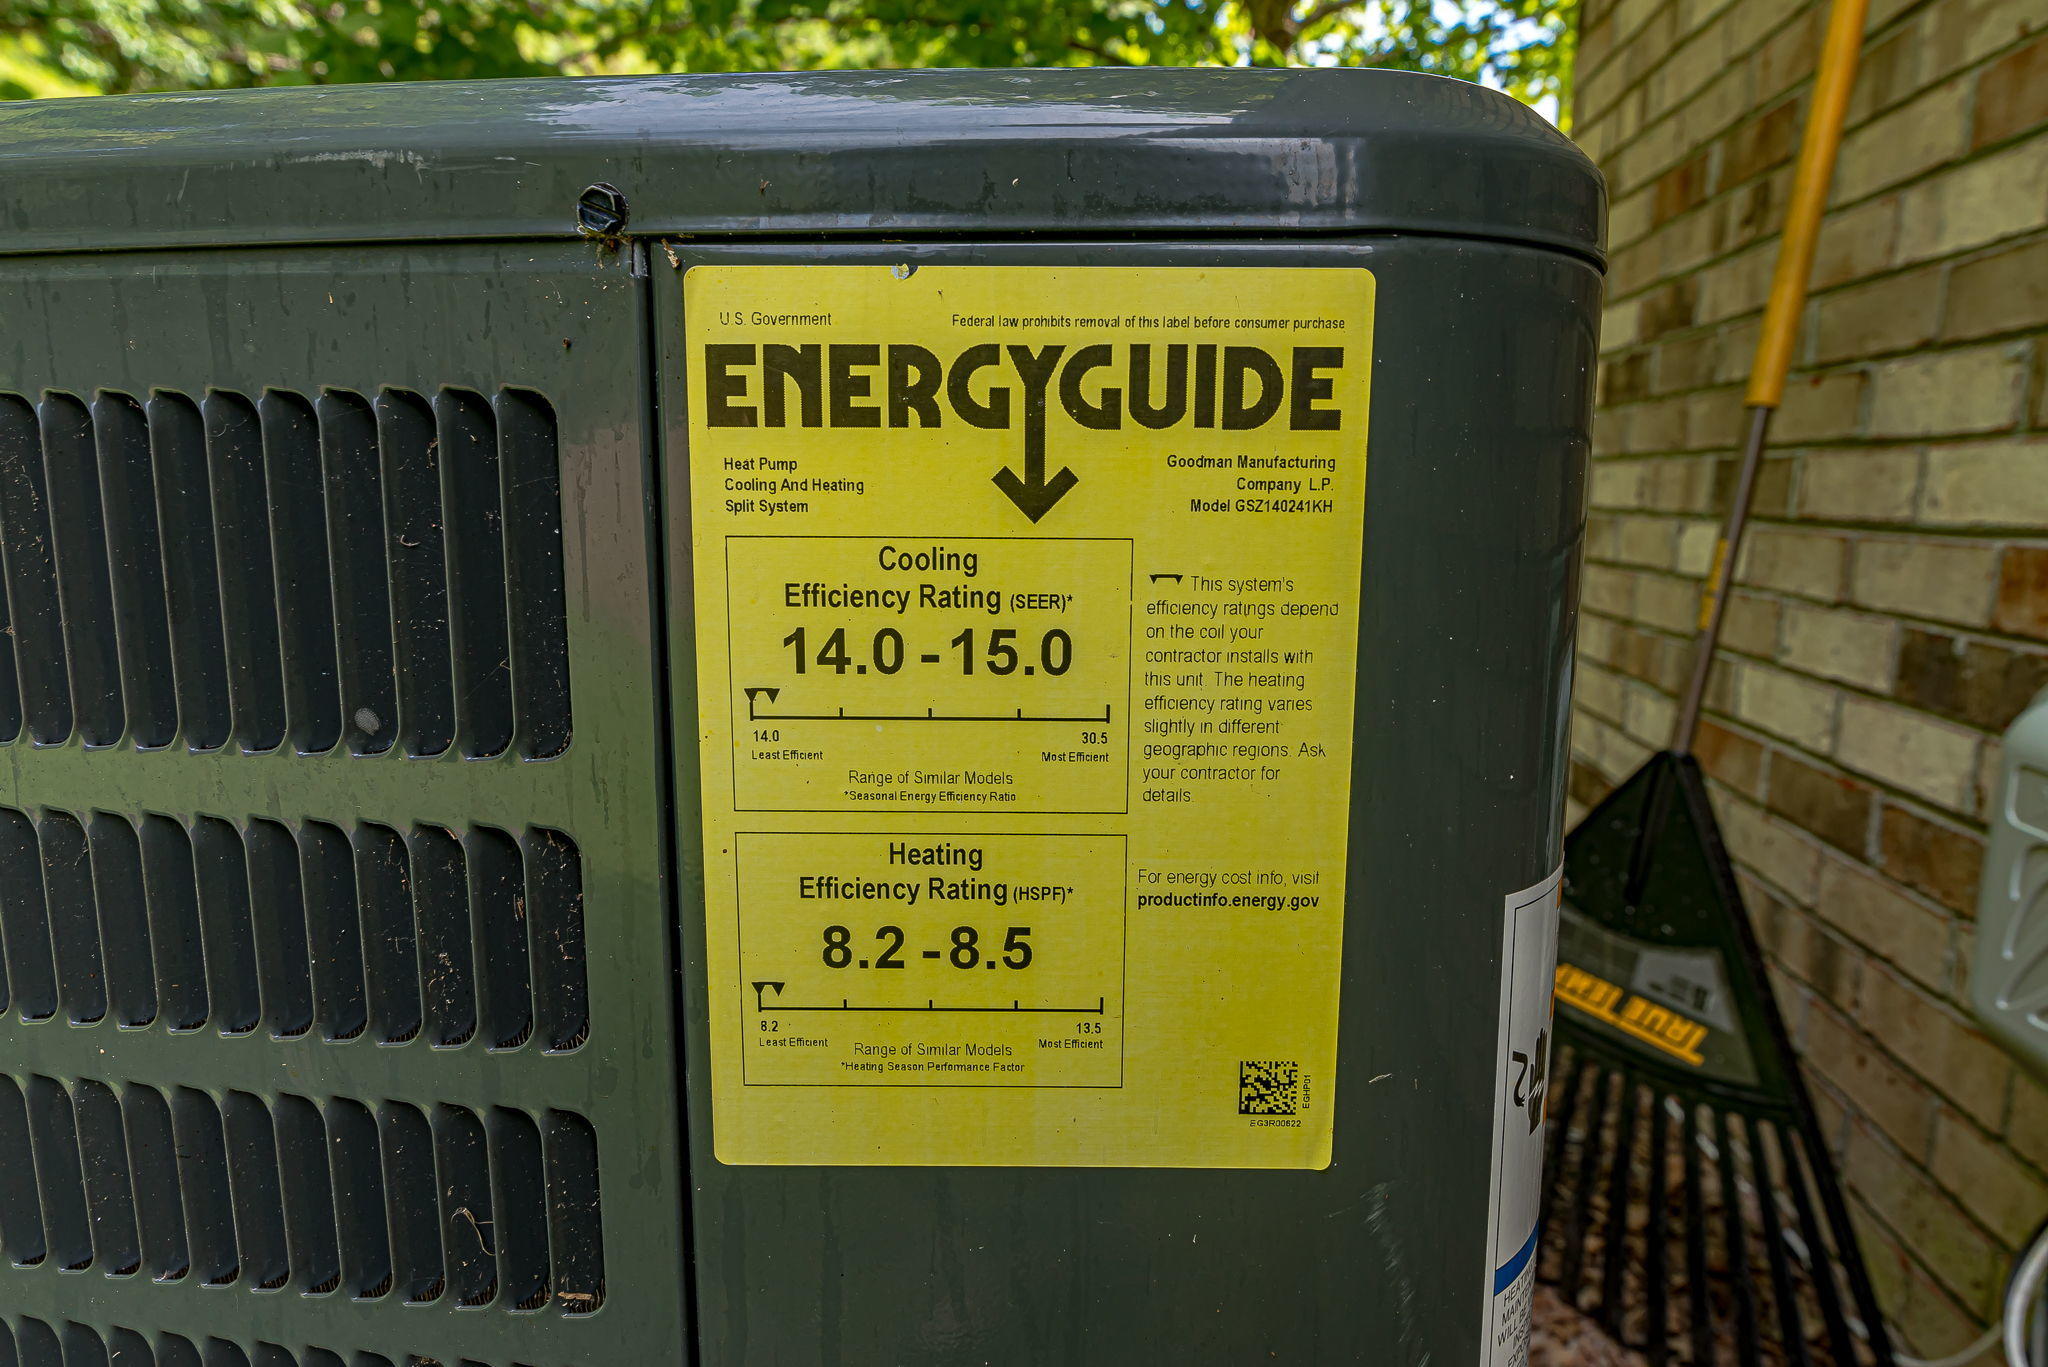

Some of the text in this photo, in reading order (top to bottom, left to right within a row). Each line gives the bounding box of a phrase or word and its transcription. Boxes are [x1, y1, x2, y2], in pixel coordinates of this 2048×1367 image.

[751, 311, 832, 327] Government
[951, 314, 1345, 333] Federal law prohibits removal of this label before consumer purchase
[704, 343, 1344, 431] ENERGYGUIDE
[723, 457, 798, 475] Heat Pump
[1166, 454, 1336, 473] Goodman Manufacturing
[724, 478, 864, 496] Cooling And Heating
[1236, 477, 1334, 495] Company L.P.
[724, 499, 809, 517] Split System
[1190, 498, 1333, 514] Model GSZ140241KH
[878, 545, 978, 577] Cooling
[1191, 575, 1294, 595] This system's
[785, 582, 910, 614] Efficiency
[919, 583, 1002, 615] Rating
[1146, 600, 1339, 619] efficiency ratings depend
[1146, 624, 1263, 643] on the coil your
[1146, 649, 1313, 664] contractor installs with
[1144, 672, 1171, 687] this
[1214, 672, 1243, 687] The
[1248, 672, 1305, 691] heating
[1144, 695, 1312, 714] efficiency rating varies
[753, 730, 780, 742] 14.0
[1144, 719, 1280, 736] slightly in different
[1081, 732, 1108, 745] 30.5
[751, 750, 823, 761] Least Efficient
[1041, 752, 1109, 763] Most Efficient
[1143, 743, 1227, 760] geographic
[1298, 742, 1326, 758] Ask
[848, 771, 1013, 787] Range of Similar Models
[1143, 766, 1280, 783] your contractor for
[900, 791, 937, 804] Energy
[939, 791, 987, 804] Efficiency
[988, 792, 1016, 802] Ratio
[889, 842, 983, 870] Heating
[1138, 869, 1319, 889] For energy cost info, visit
[799, 876, 920, 905] Efficiency
[928, 878, 1008, 905] Rating
[1138, 892, 1319, 912] productinfo.energy.gov
[760, 1021, 778, 1032] 8.2
[1076, 1022, 1102, 1034] 13.5
[1619, 995, 1708, 1067] TRUE
[759, 1037, 828, 1048] Least Efficient
[854, 1042, 1012, 1058] Range of Similar Models
[1038, 1038, 1103, 1049] Most Efficient
[887, 1061, 924, 1073] Season
[927, 1061, 990, 1073] Performance
[993, 1062, 1025, 1073] Factor
[1497, 1318, 1518, 1347] WILL
